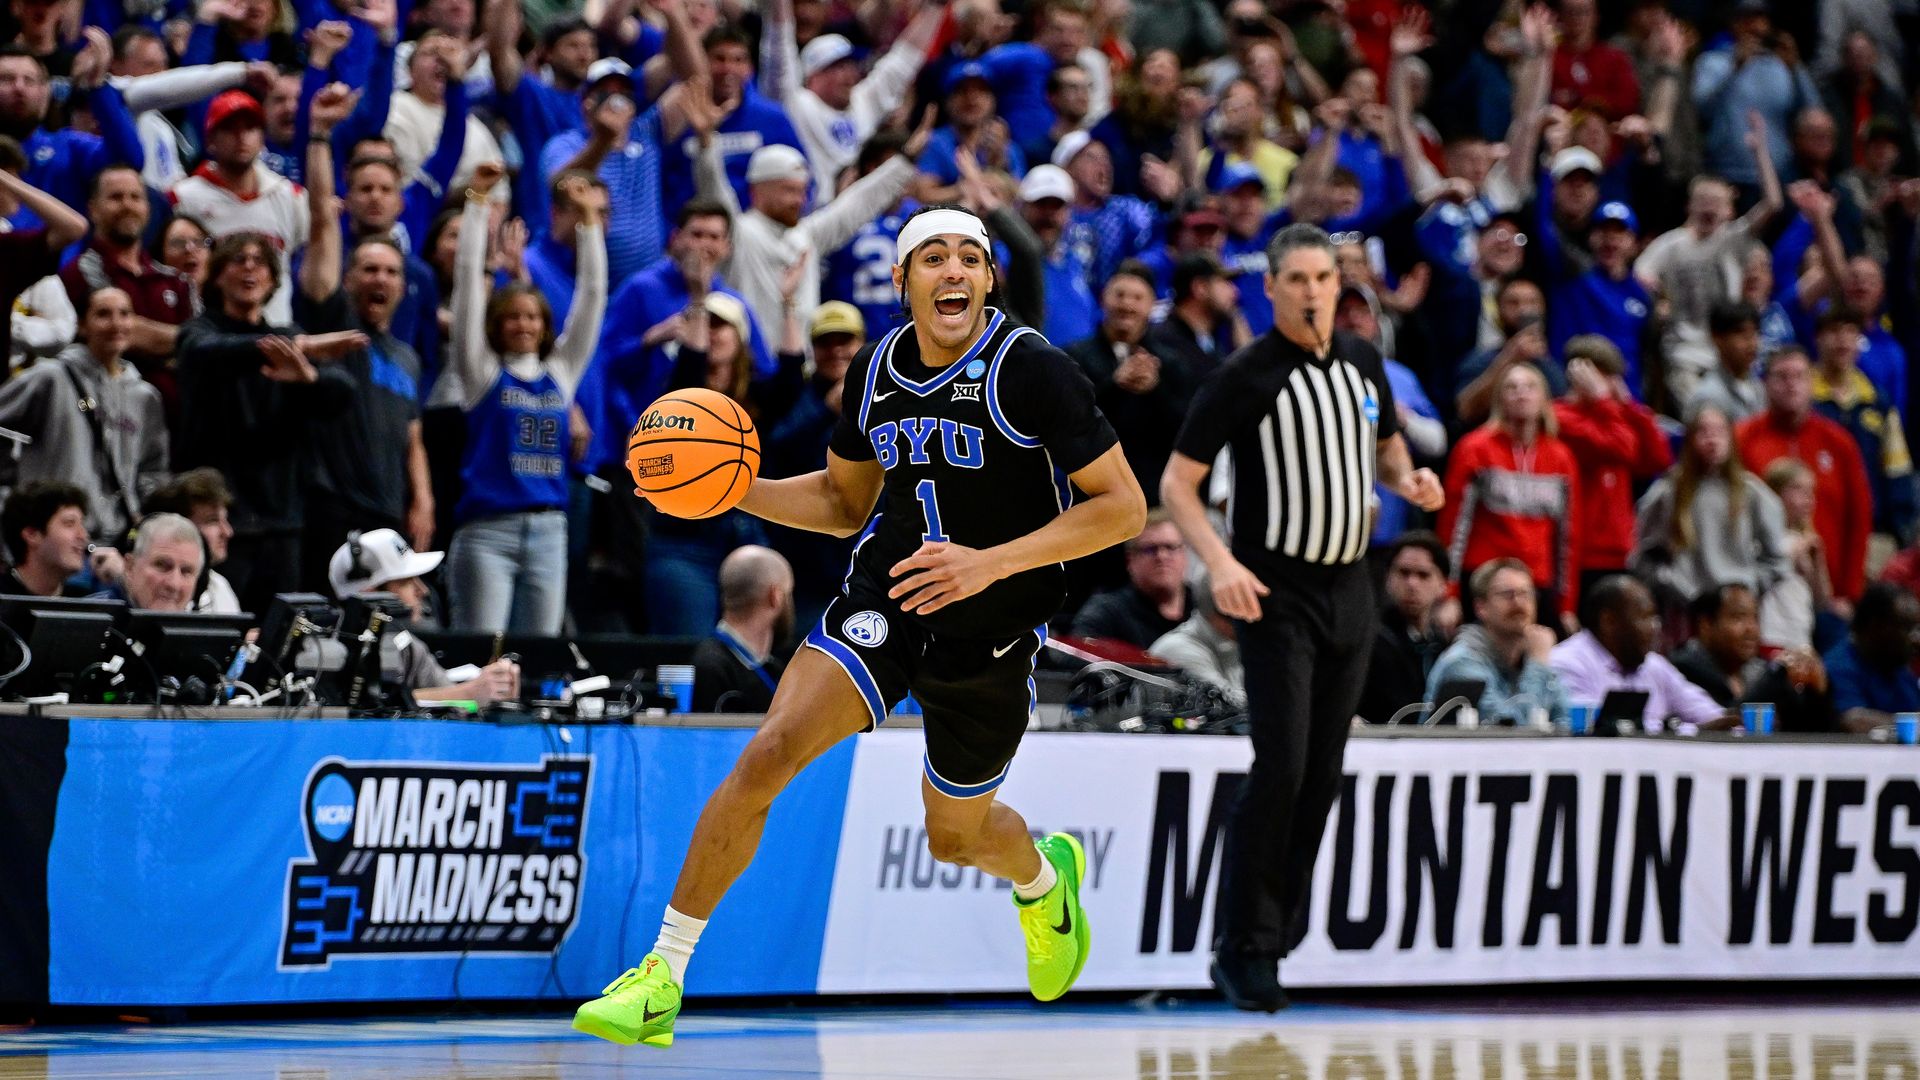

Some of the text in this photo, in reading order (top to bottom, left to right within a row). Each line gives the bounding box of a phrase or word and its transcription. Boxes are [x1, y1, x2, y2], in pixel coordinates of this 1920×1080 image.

[515, 414, 559, 450] 32
[869, 417, 984, 470] BYU
[915, 479, 950, 543] 1
[353, 777, 507, 849] MARCH
[370, 853, 578, 924] MADNESS
[1064, 828, 1116, 890] Y
[1139, 771, 1693, 953] MUNTAIN
